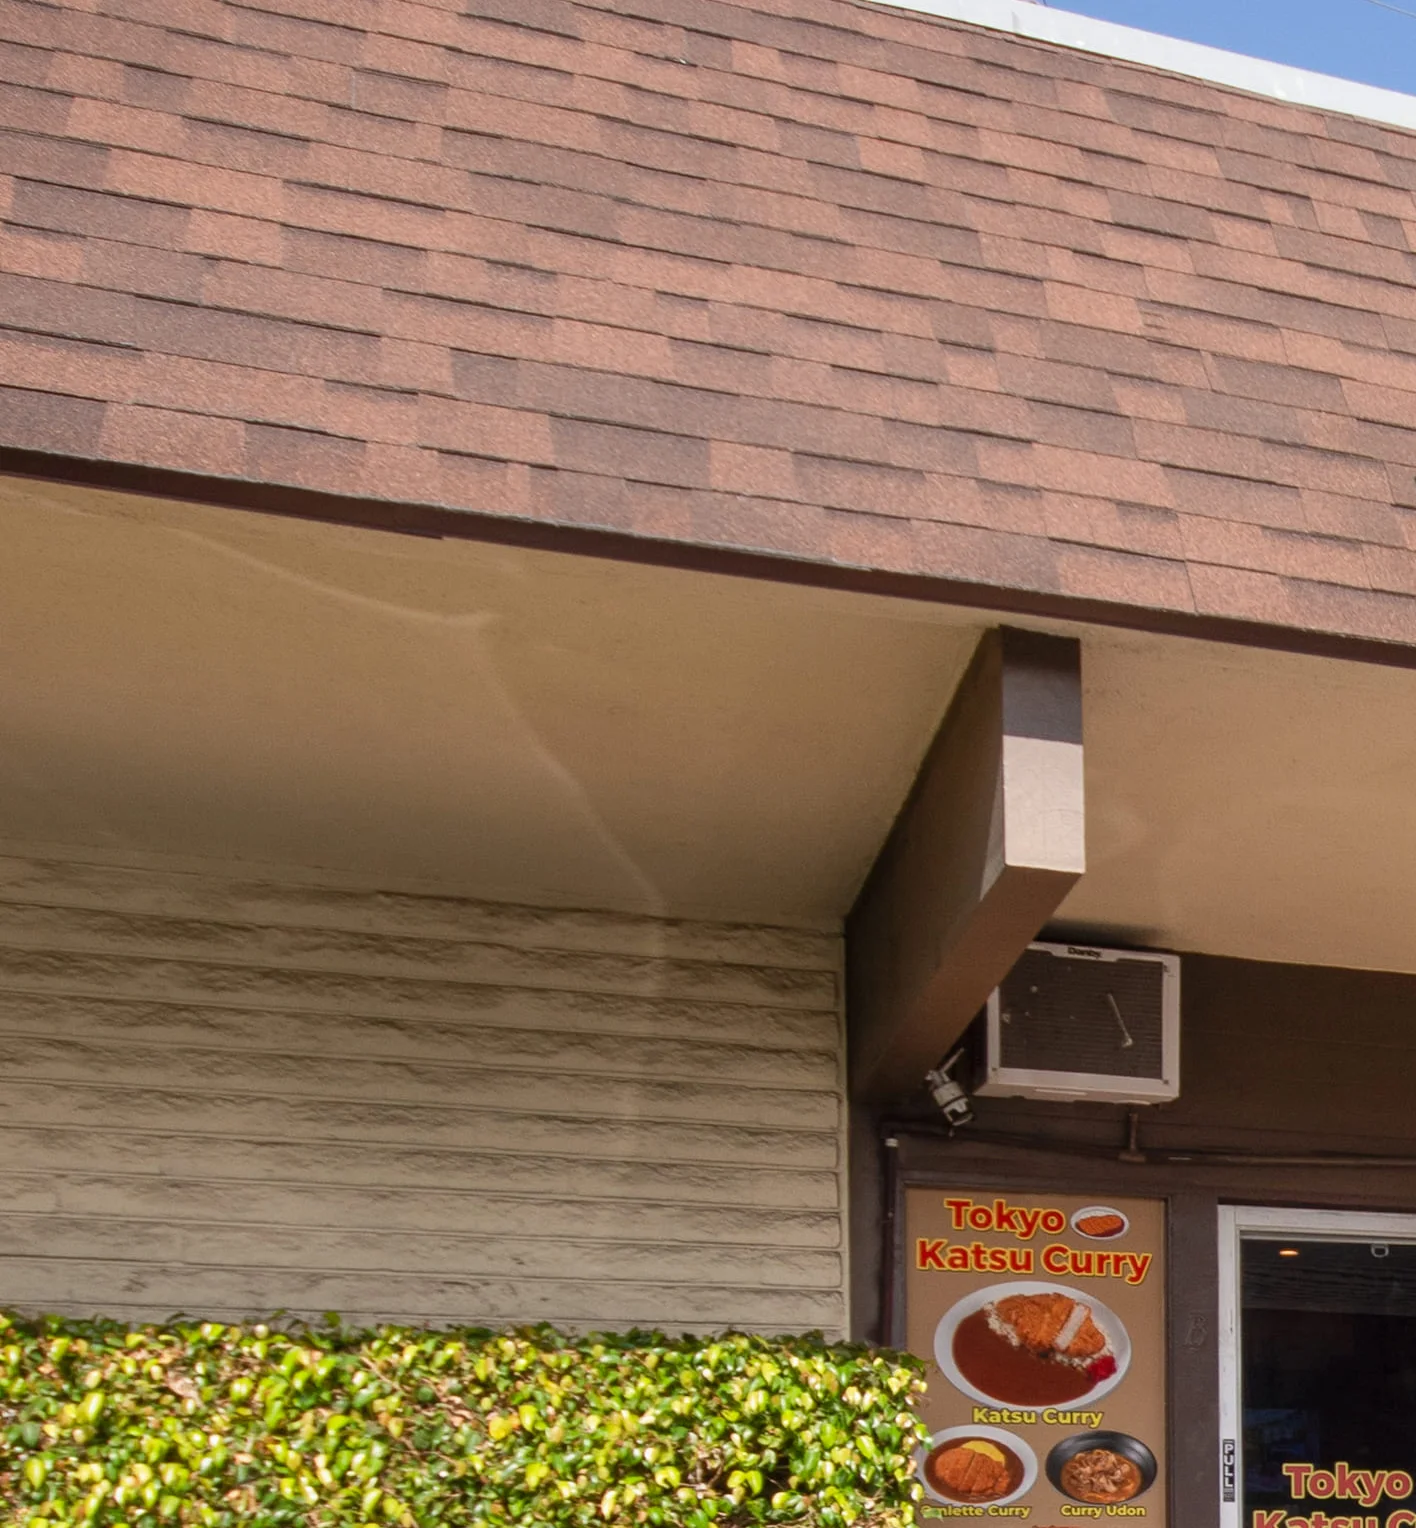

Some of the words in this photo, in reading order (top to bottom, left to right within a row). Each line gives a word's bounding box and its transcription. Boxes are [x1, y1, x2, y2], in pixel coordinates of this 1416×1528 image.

[944, 1198, 1066, 1240] Tokyo
[916, 1238, 1034, 1273] Katsu
[1041, 1243, 1152, 1285] Curry
[972, 1407, 1036, 1424] Katsu
[1042, 1408, 1103, 1428] Curry
[1223, 1443, 1234, 1488] PULL
[1282, 1461, 1414, 1507] Tokyo
[987, 1504, 1030, 1519] Curry
[1060, 1504, 1103, 1519] Curry
[1106, 1504, 1146, 1516] Udon
